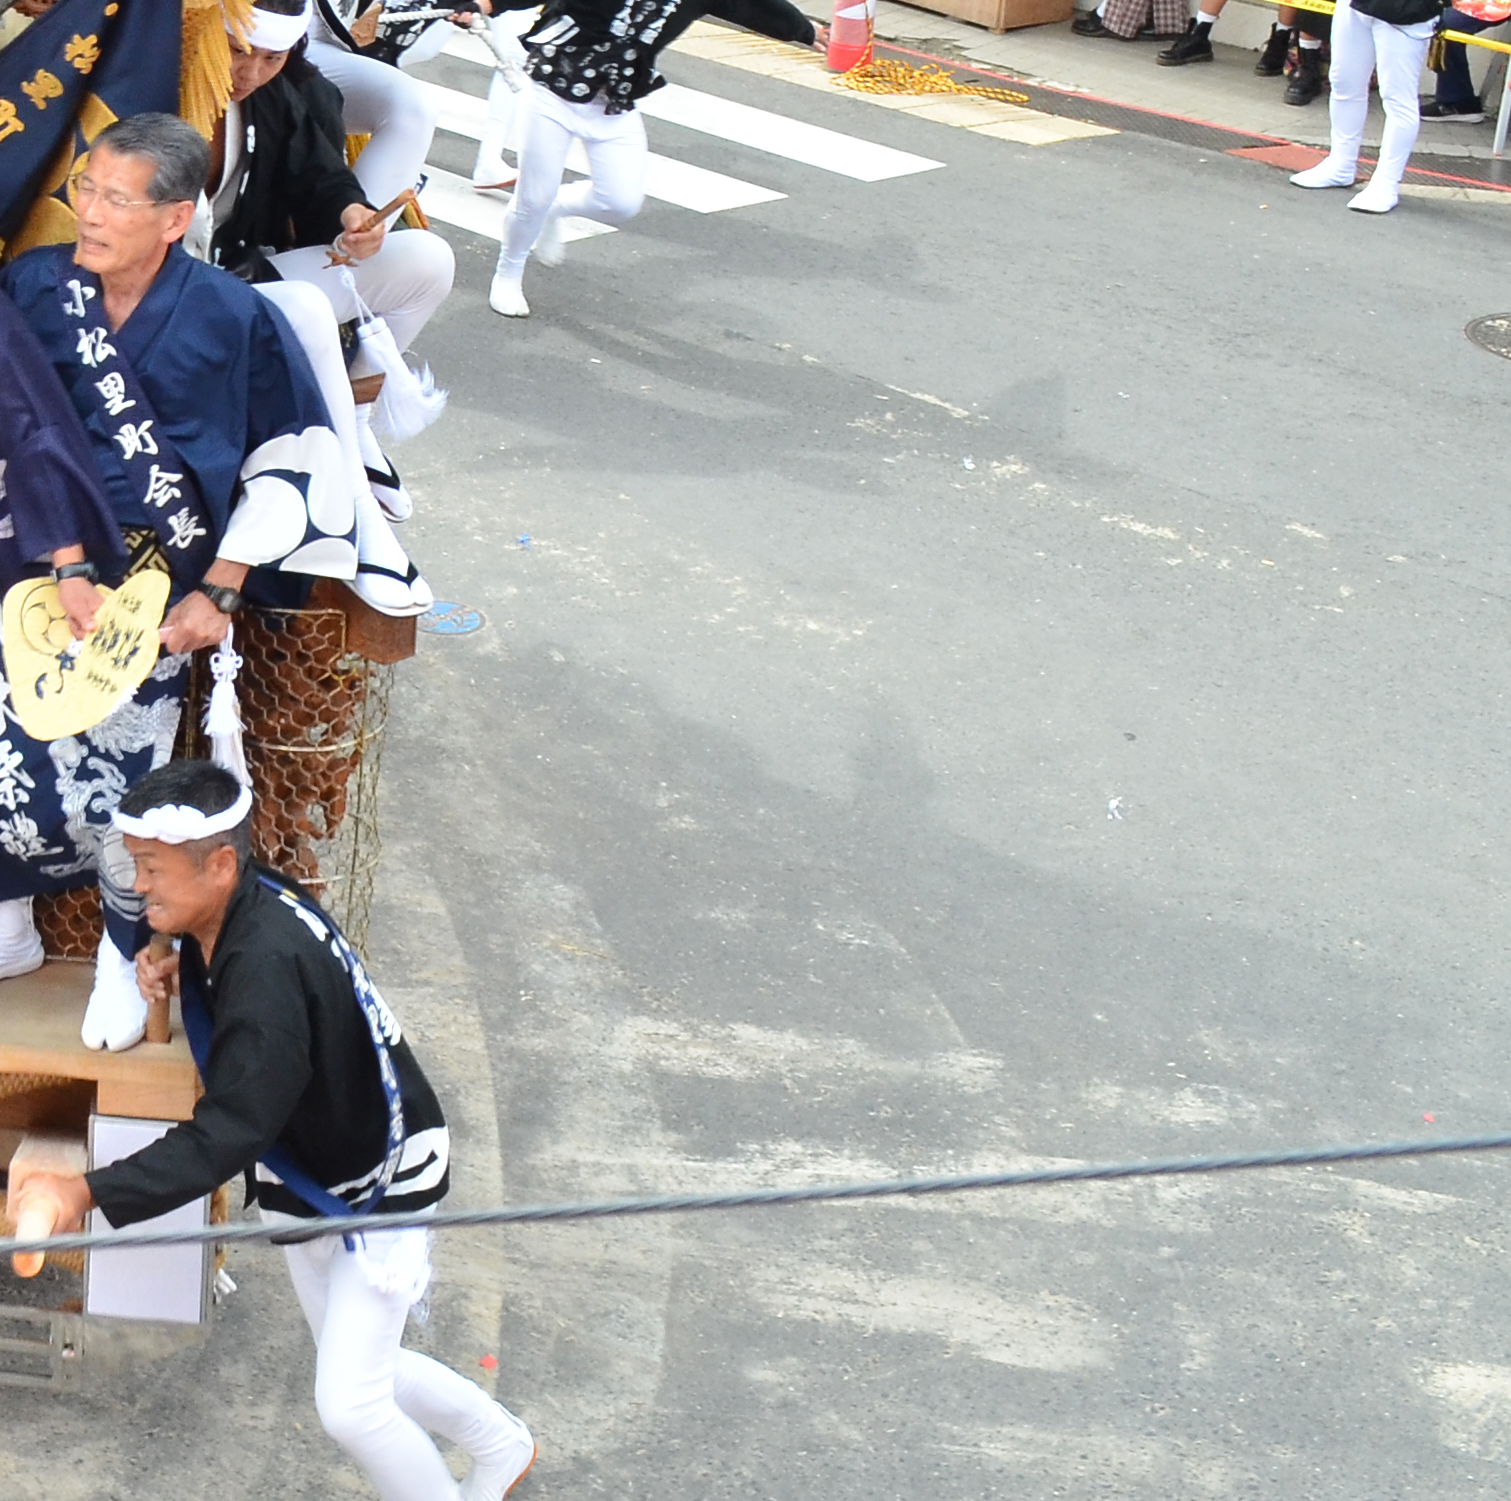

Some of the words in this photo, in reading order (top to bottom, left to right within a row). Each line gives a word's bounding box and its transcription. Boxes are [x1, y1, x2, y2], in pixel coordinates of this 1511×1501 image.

[63, 278, 208, 550] 小松里町会長
